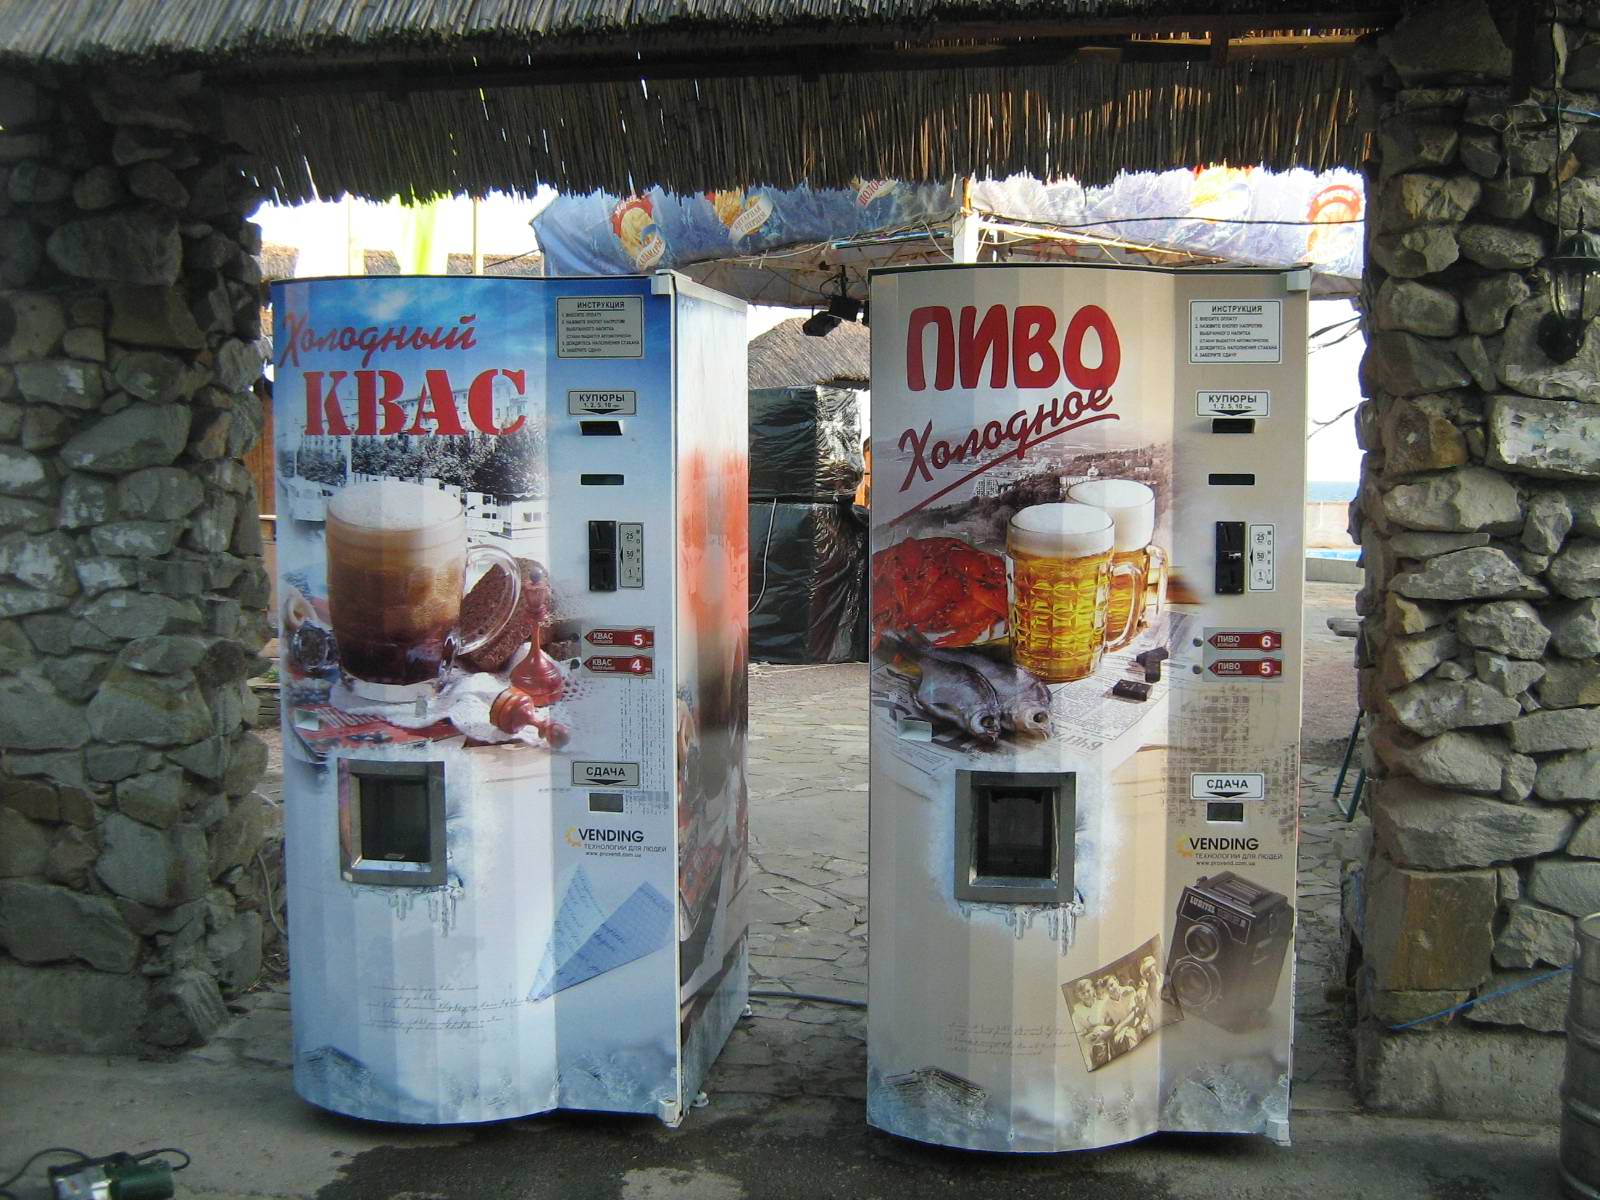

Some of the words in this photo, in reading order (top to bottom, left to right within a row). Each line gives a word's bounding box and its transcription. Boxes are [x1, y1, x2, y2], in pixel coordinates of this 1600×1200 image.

[577, 301, 625, 309] ИНСТРУКЦИЯ
[1211, 305, 1263, 313] ИНСТРУКЦИЯ
[279, 313, 477, 368] Холодный
[907, 304, 1121, 391] ПИВО
[303, 368, 527, 436] КВАС
[579, 393, 625, 402] КУПЮРЫ
[1208, 394, 1257, 403] КУПЮРЫ
[898, 387, 1114, 493] Холодное
[593, 632, 614, 640] КВАС
[633, 634, 643, 646] 5
[1217, 635, 1240, 643] ПИВО
[1261, 635, 1272, 648] 6
[592, 658, 613, 666] КВАС
[631, 658, 642, 671] 4
[1217, 662, 1241, 670] ПИВО
[1261, 662, 1271, 674] 5
[586, 766, 626, 777] СДАЧА
[1206, 779, 1249, 790] СДАЧА
[578, 828, 644, 843] VENDING
[584, 843, 627, 851] ТЕХНОЛОГИИ
[643, 845, 667, 853] ЛЮДЕЙ
[1189, 837, 1260, 851] VENDING
